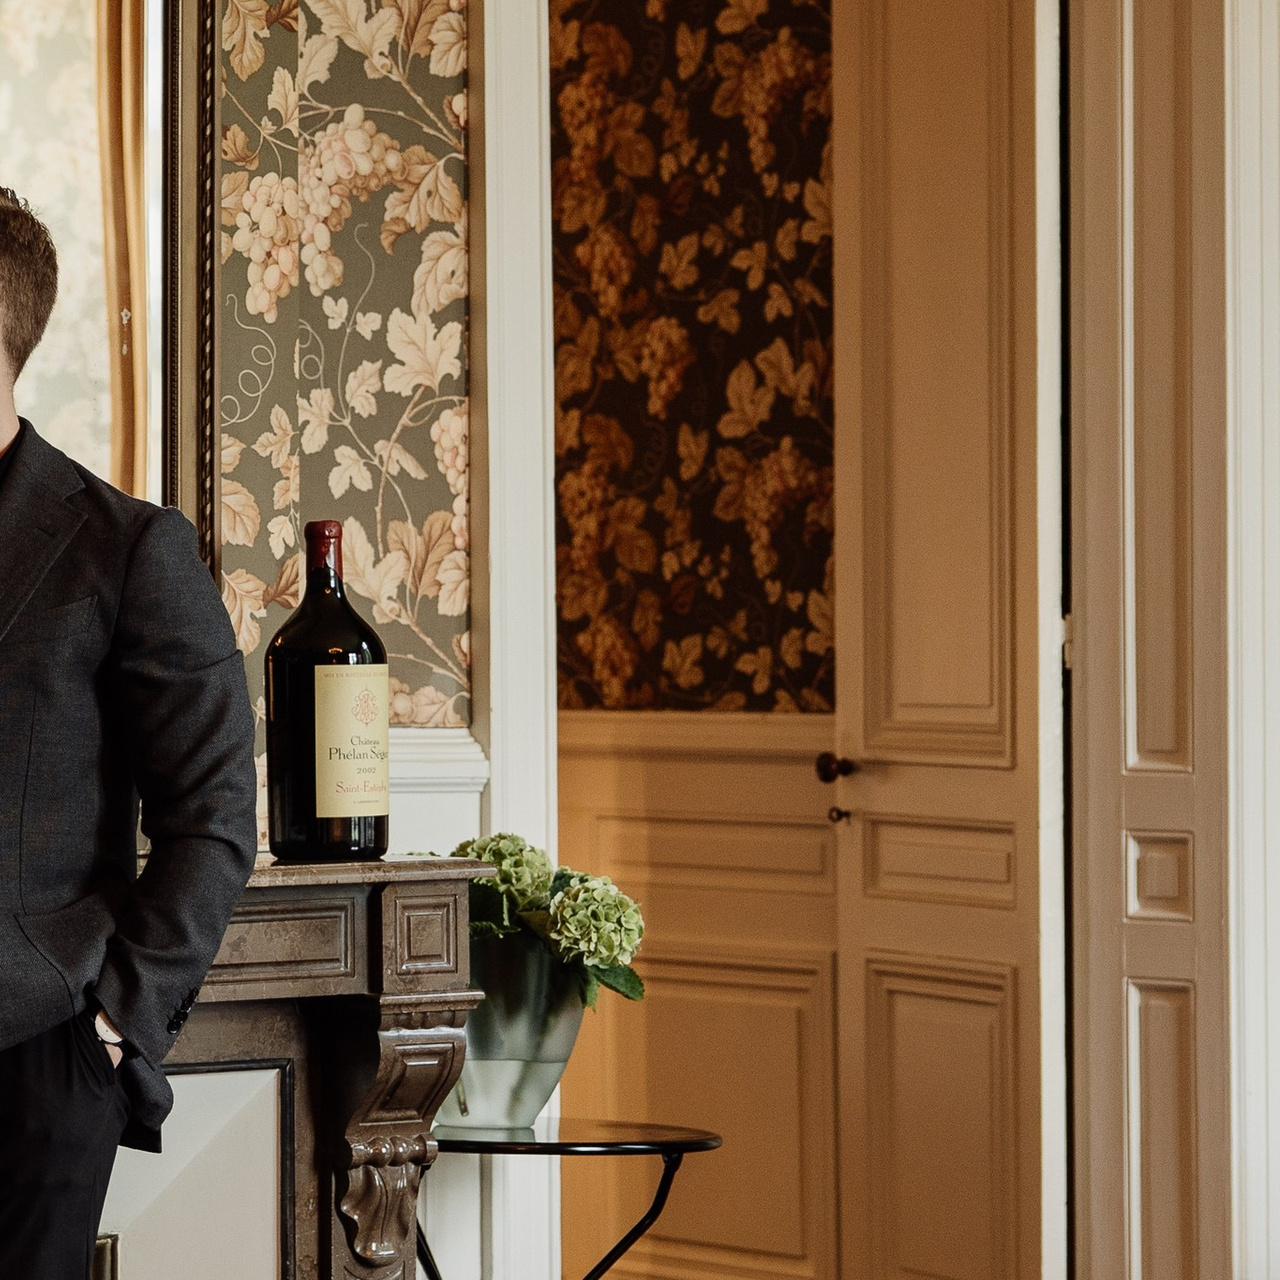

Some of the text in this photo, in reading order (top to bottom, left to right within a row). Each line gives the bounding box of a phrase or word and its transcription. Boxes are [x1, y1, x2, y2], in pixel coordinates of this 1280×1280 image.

[350, 735, 380, 746] Château
[328, 747, 369, 760] Phélan
[356, 767, 376, 775] 2002
